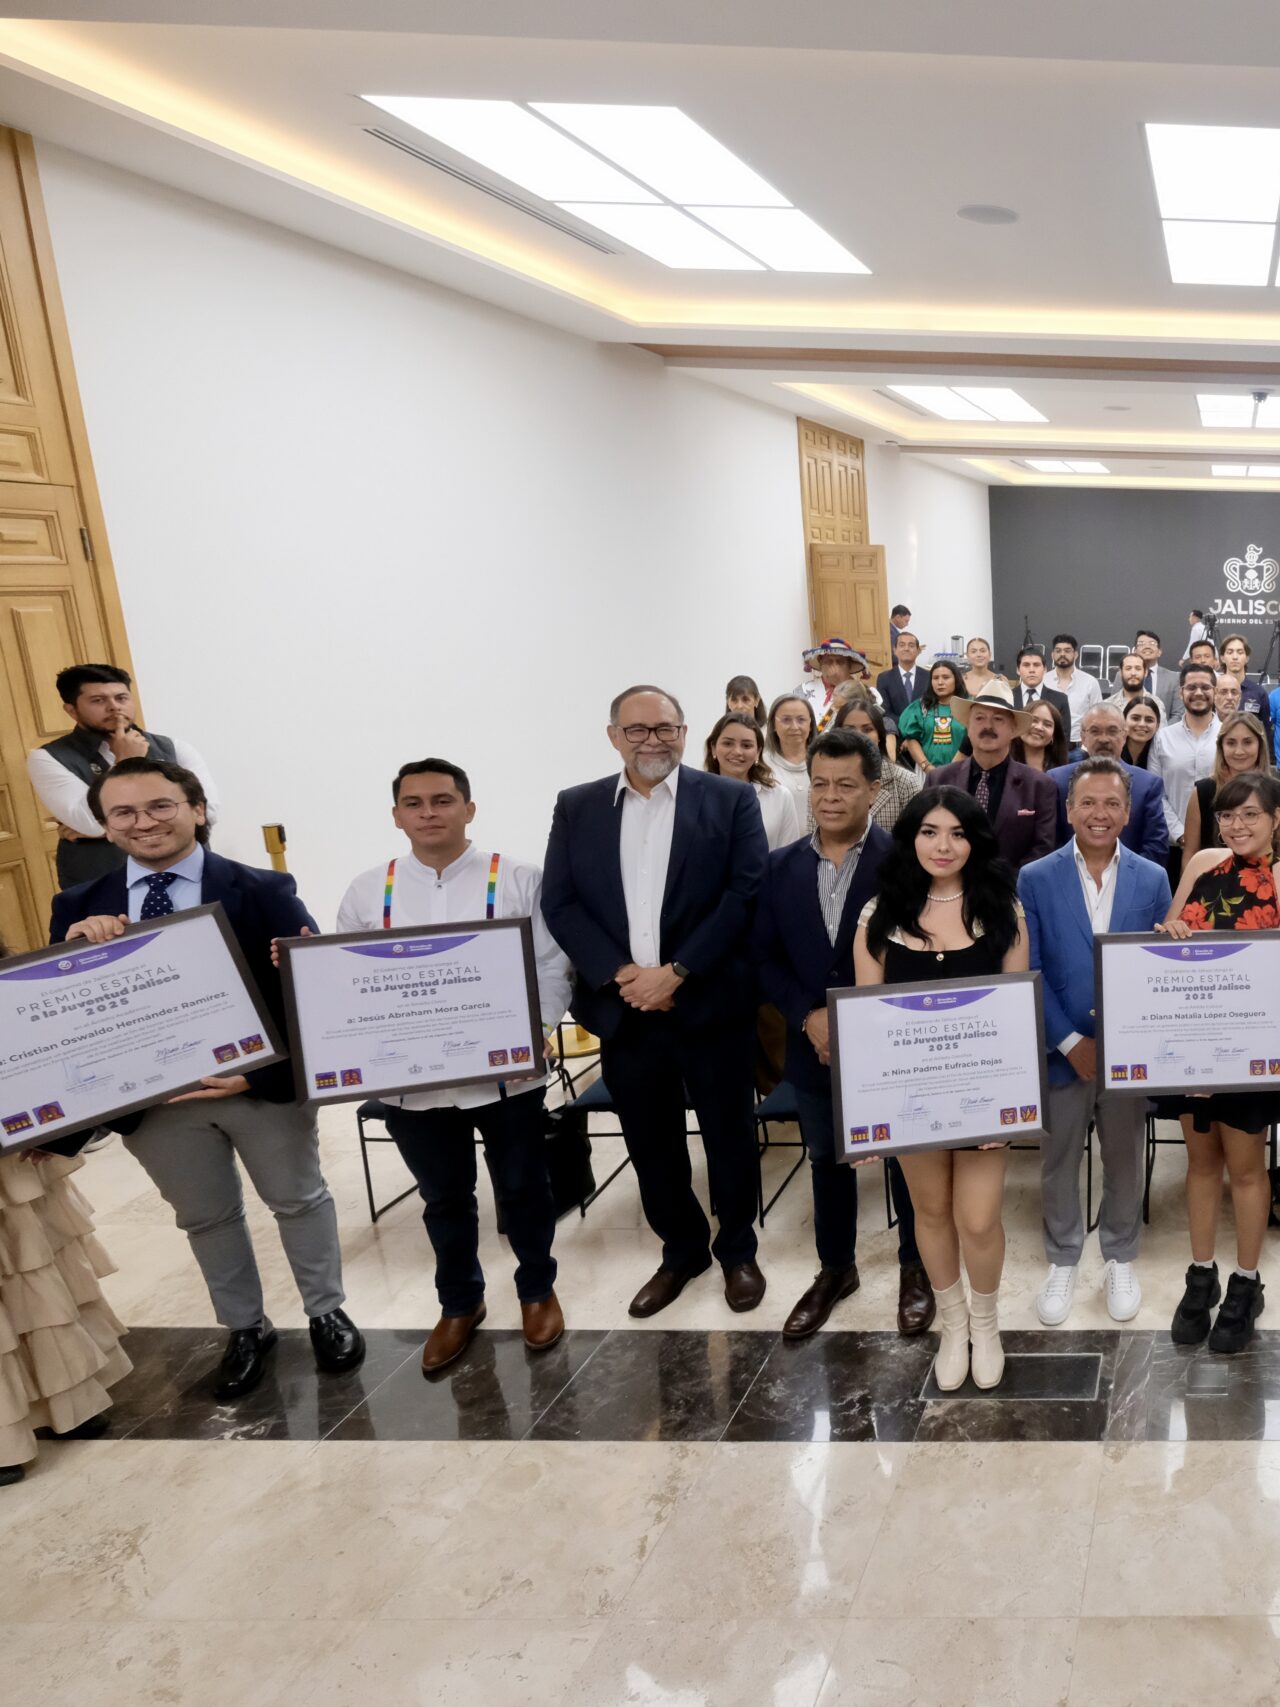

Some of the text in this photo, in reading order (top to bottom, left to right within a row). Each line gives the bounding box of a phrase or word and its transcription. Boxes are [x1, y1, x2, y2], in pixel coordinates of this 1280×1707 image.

[352, 965, 481, 986] PREMIO ESTATAL
[360, 974, 482, 994] a la Juventud Jalisco
[1147, 973, 1251, 985] PREMIO ESTATAL
[16, 964, 176, 1016] PREMIO ESTATAL
[401, 988, 437, 998] 2025
[1160, 985, 1170, 993] la
[1171, 984, 1216, 993] Juventud
[1217, 982, 1251, 991] Jalisco
[30, 974, 180, 1022] a la Juventud Jalisco
[85, 998, 129, 1016] 2025
[358, 1014, 385, 1023] Jesús
[388, 1009, 432, 1019] Abraham
[435, 1006, 459, 1014] Mora
[1150, 1013, 1173, 1021] Diana
[1174, 1011, 1202, 1020] Natalia
[1228, 1011, 1266, 1021] Oseguera
[9, 1043, 58, 1062] Cristian
[61, 1026, 114, 1046] Oswaldo
[116, 1006, 179, 1029] Hernández
[887, 1019, 997, 1038] PREMIO ESTATAL
[902, 1038, 911, 1046] la
[913, 1033, 961, 1045] Juventud
[962, 1030, 998, 1039] Jalisco
[928, 1042, 959, 1052] 2025
[891, 1068, 911, 1076] Nina
[913, 1064, 943, 1073] Padme
[944, 1060, 979, 1070] Eufracio
[980, 1057, 1003, 1067] Rojas
